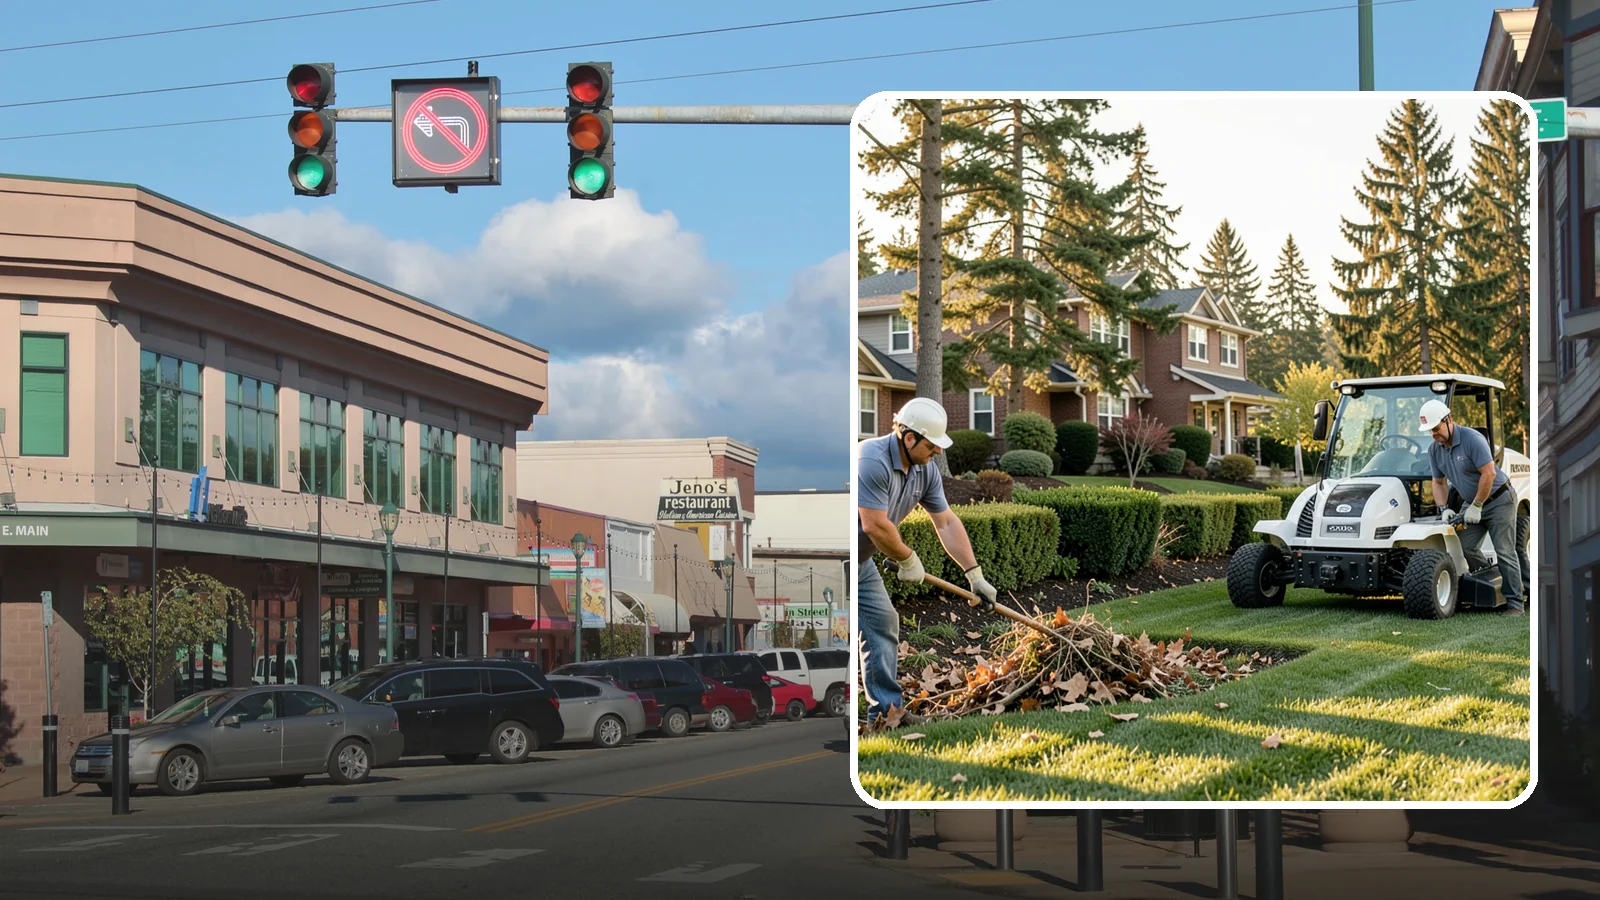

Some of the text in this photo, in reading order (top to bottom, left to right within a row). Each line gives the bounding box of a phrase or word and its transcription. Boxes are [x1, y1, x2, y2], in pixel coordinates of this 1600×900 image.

[669, 479, 727, 495] Jeno's
[665, 496, 731, 509] restaurant
[658, 509, 681, 520] Italian
[685, 509, 714, 519] American
[714, 509, 737, 519] Cuisine
[2, 525, 49, 536] E. MAIN
[797, 607, 828, 617] Street
[790, 619, 824, 627] lass
